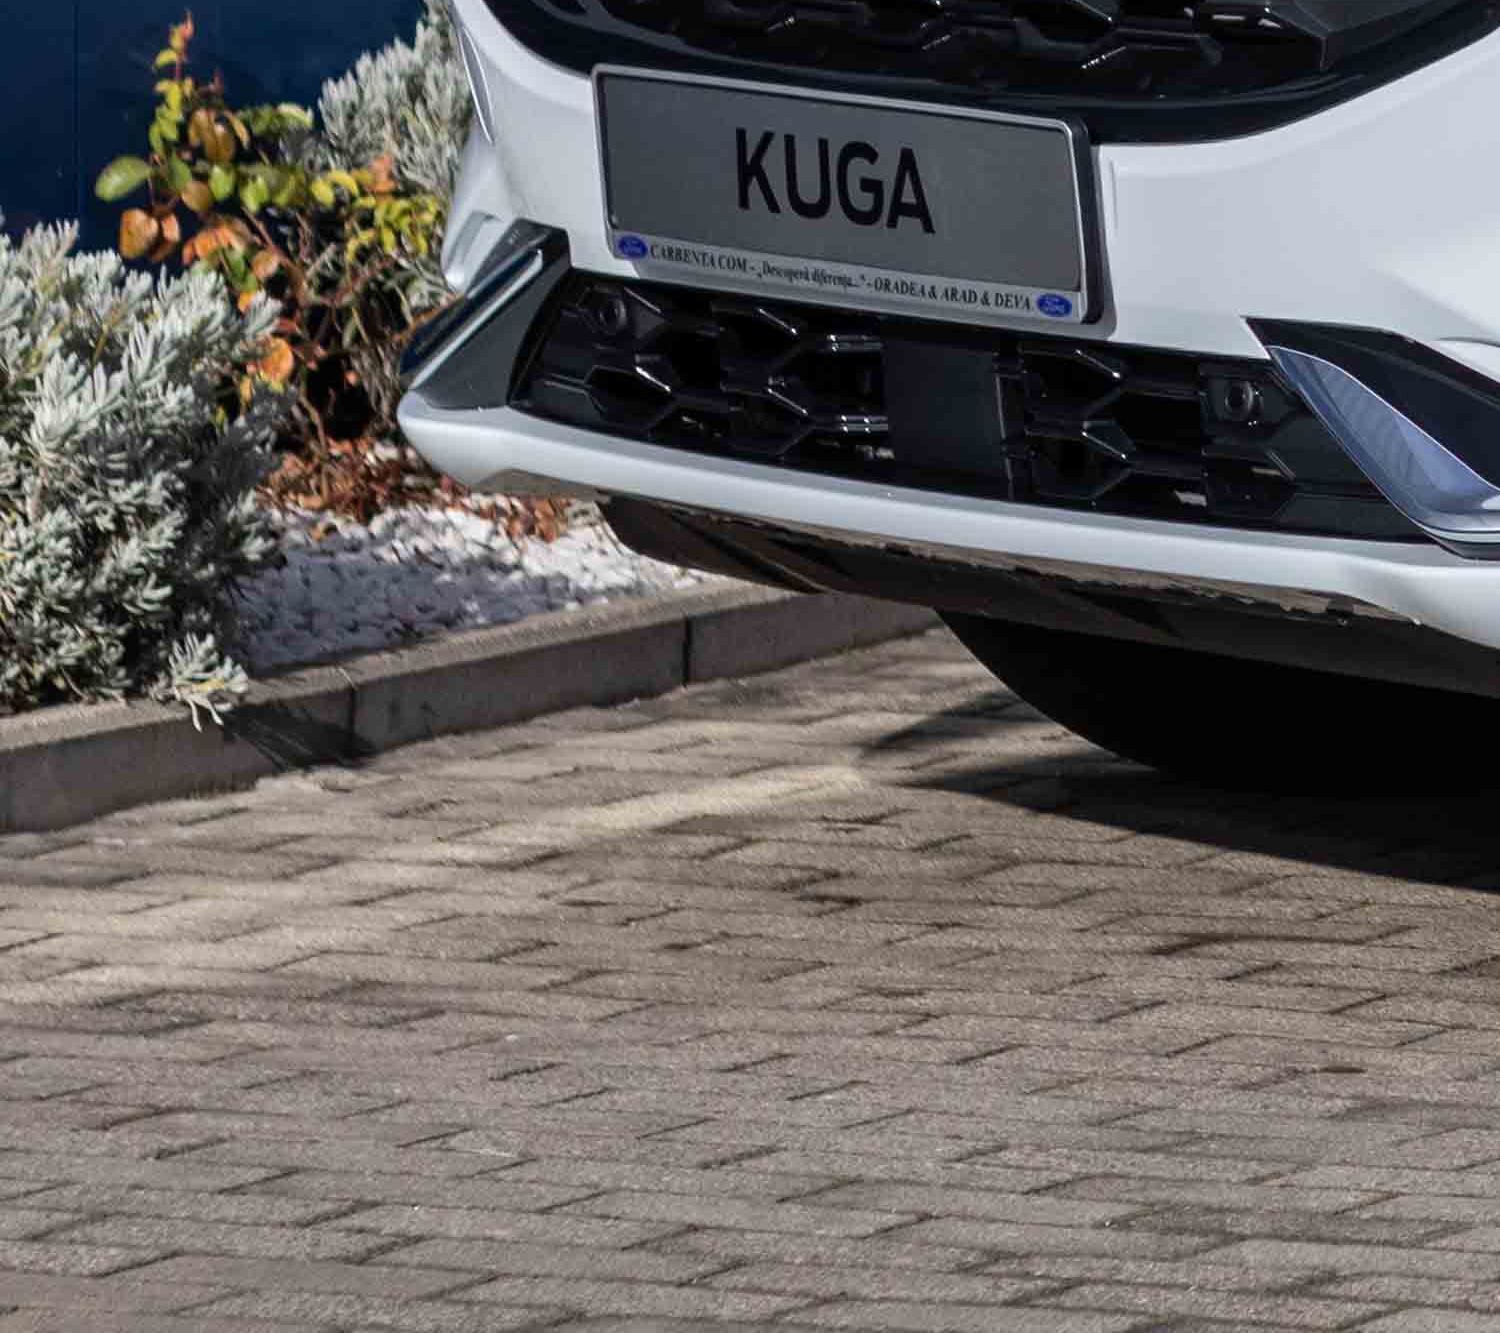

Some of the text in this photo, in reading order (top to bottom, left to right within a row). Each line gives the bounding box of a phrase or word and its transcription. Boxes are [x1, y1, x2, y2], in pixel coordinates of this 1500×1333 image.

[735, 127, 936, 234] KUGA
[651, 244, 717, 268] CARBENTA
[718, 255, 747, 271] COM
[875, 277, 925, 301] ORADEA
[927, 286, 939, 300] &
[941, 286, 977, 304] ARAD
[980, 293, 991, 306] &
[994, 292, 1032, 310] DEVA
